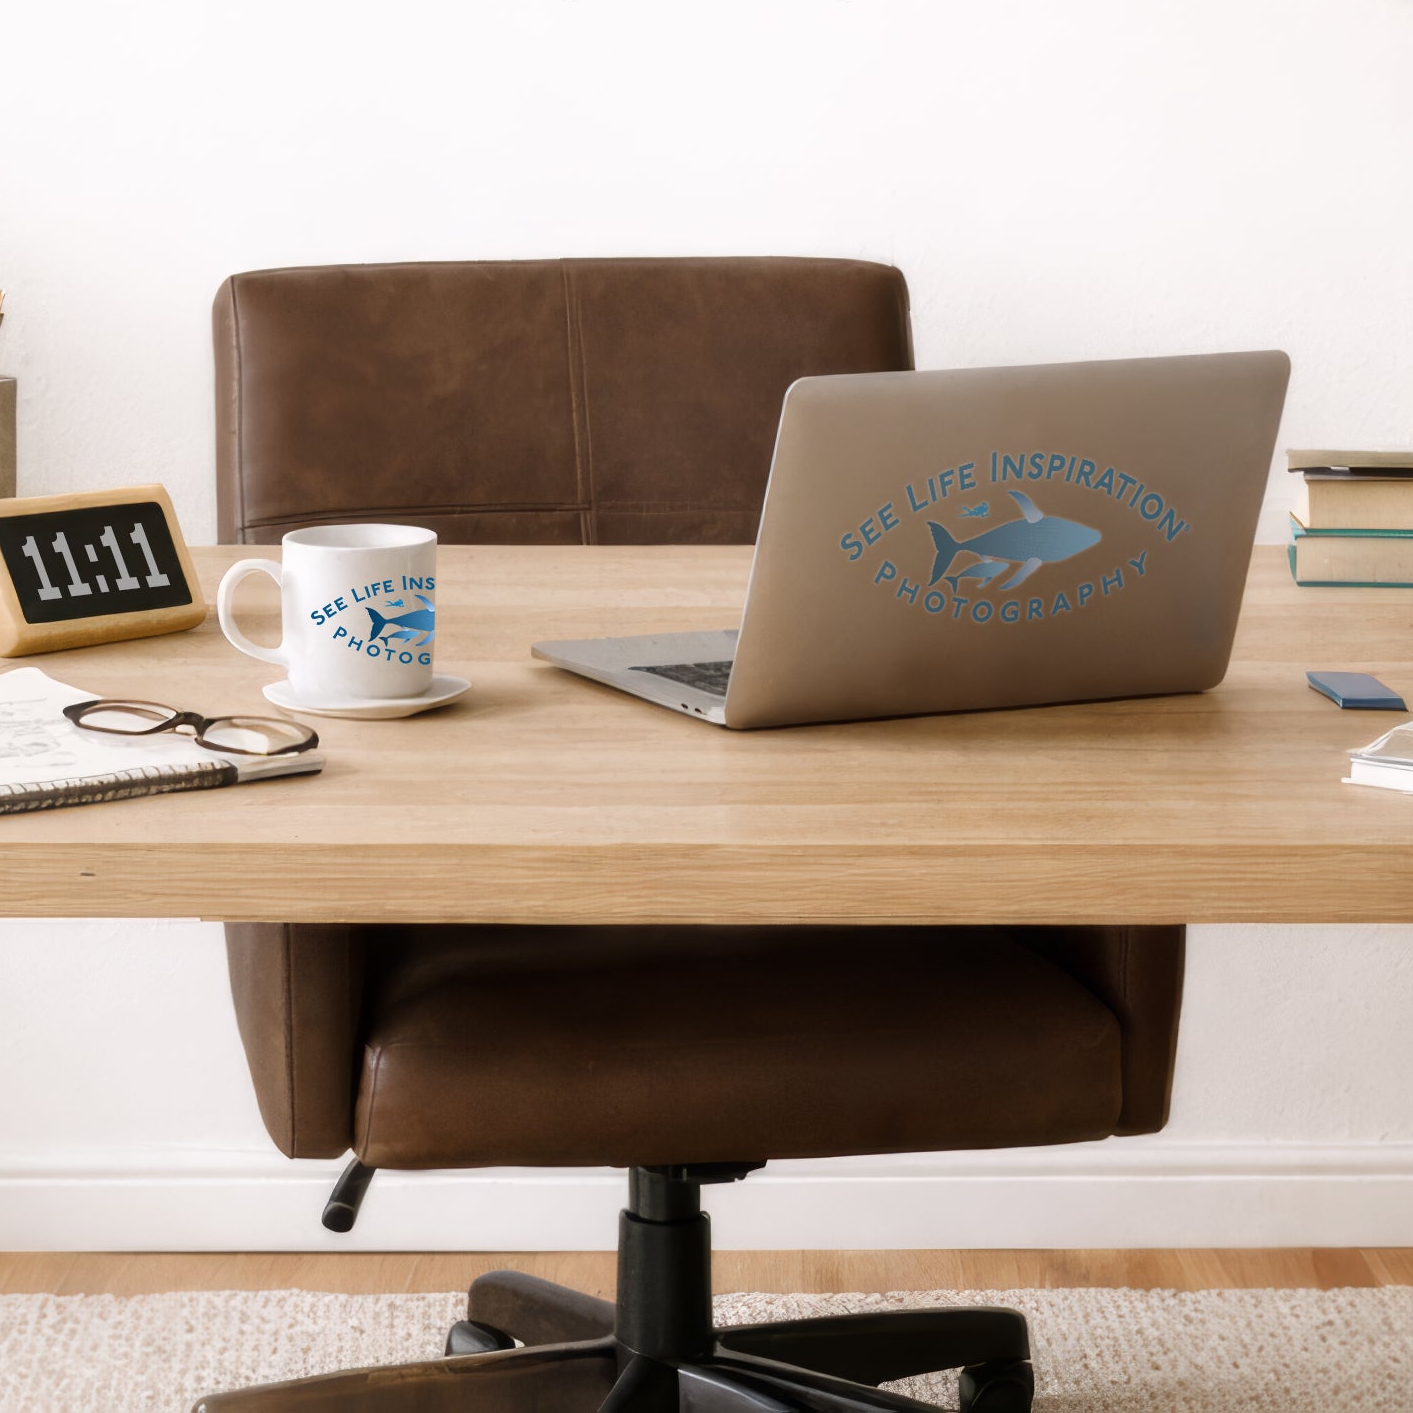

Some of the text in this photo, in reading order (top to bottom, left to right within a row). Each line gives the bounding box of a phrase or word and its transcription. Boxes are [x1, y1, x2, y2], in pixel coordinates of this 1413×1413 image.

[840, 503, 900, 561] SEE
[905, 462, 977, 513] LIFE
[21, 522, 171, 601] 11:11
[874, 550, 1148, 623] PHOTOGRAPHY
[310, 597, 348, 626] SEE
[351, 580, 395, 603] LIFE
